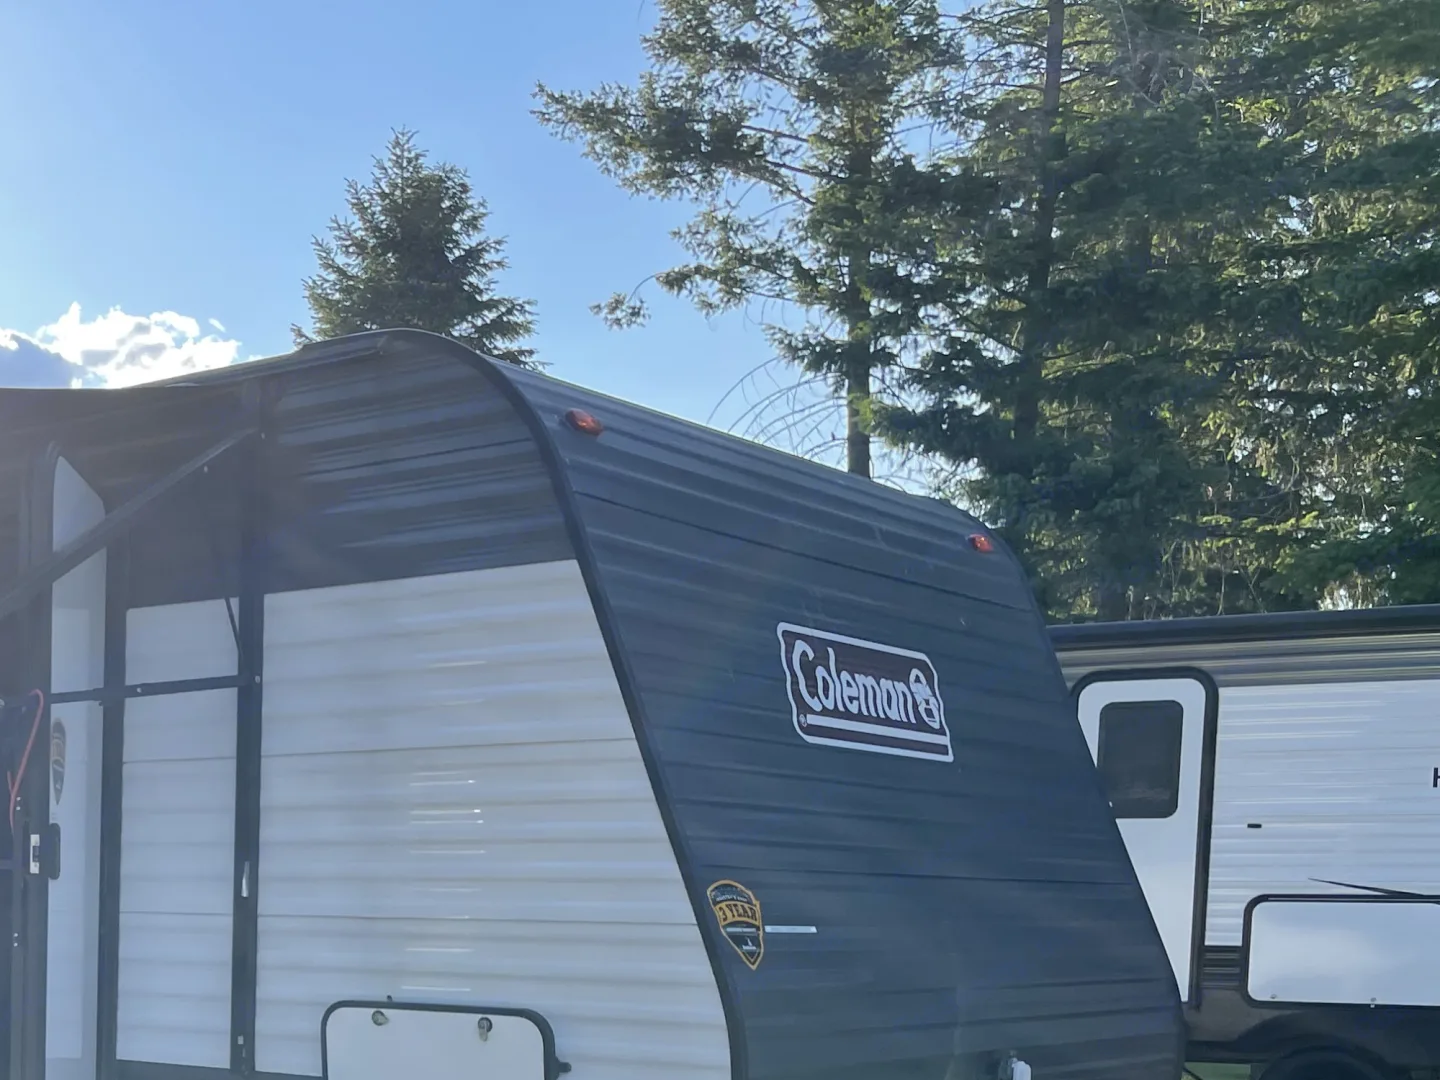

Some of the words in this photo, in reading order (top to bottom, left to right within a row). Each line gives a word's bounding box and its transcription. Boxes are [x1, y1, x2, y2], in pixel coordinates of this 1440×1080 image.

[792, 640, 917, 724] Coleman
[718, 905, 728, 922] 3
[725, 903, 758, 922] YEAR
